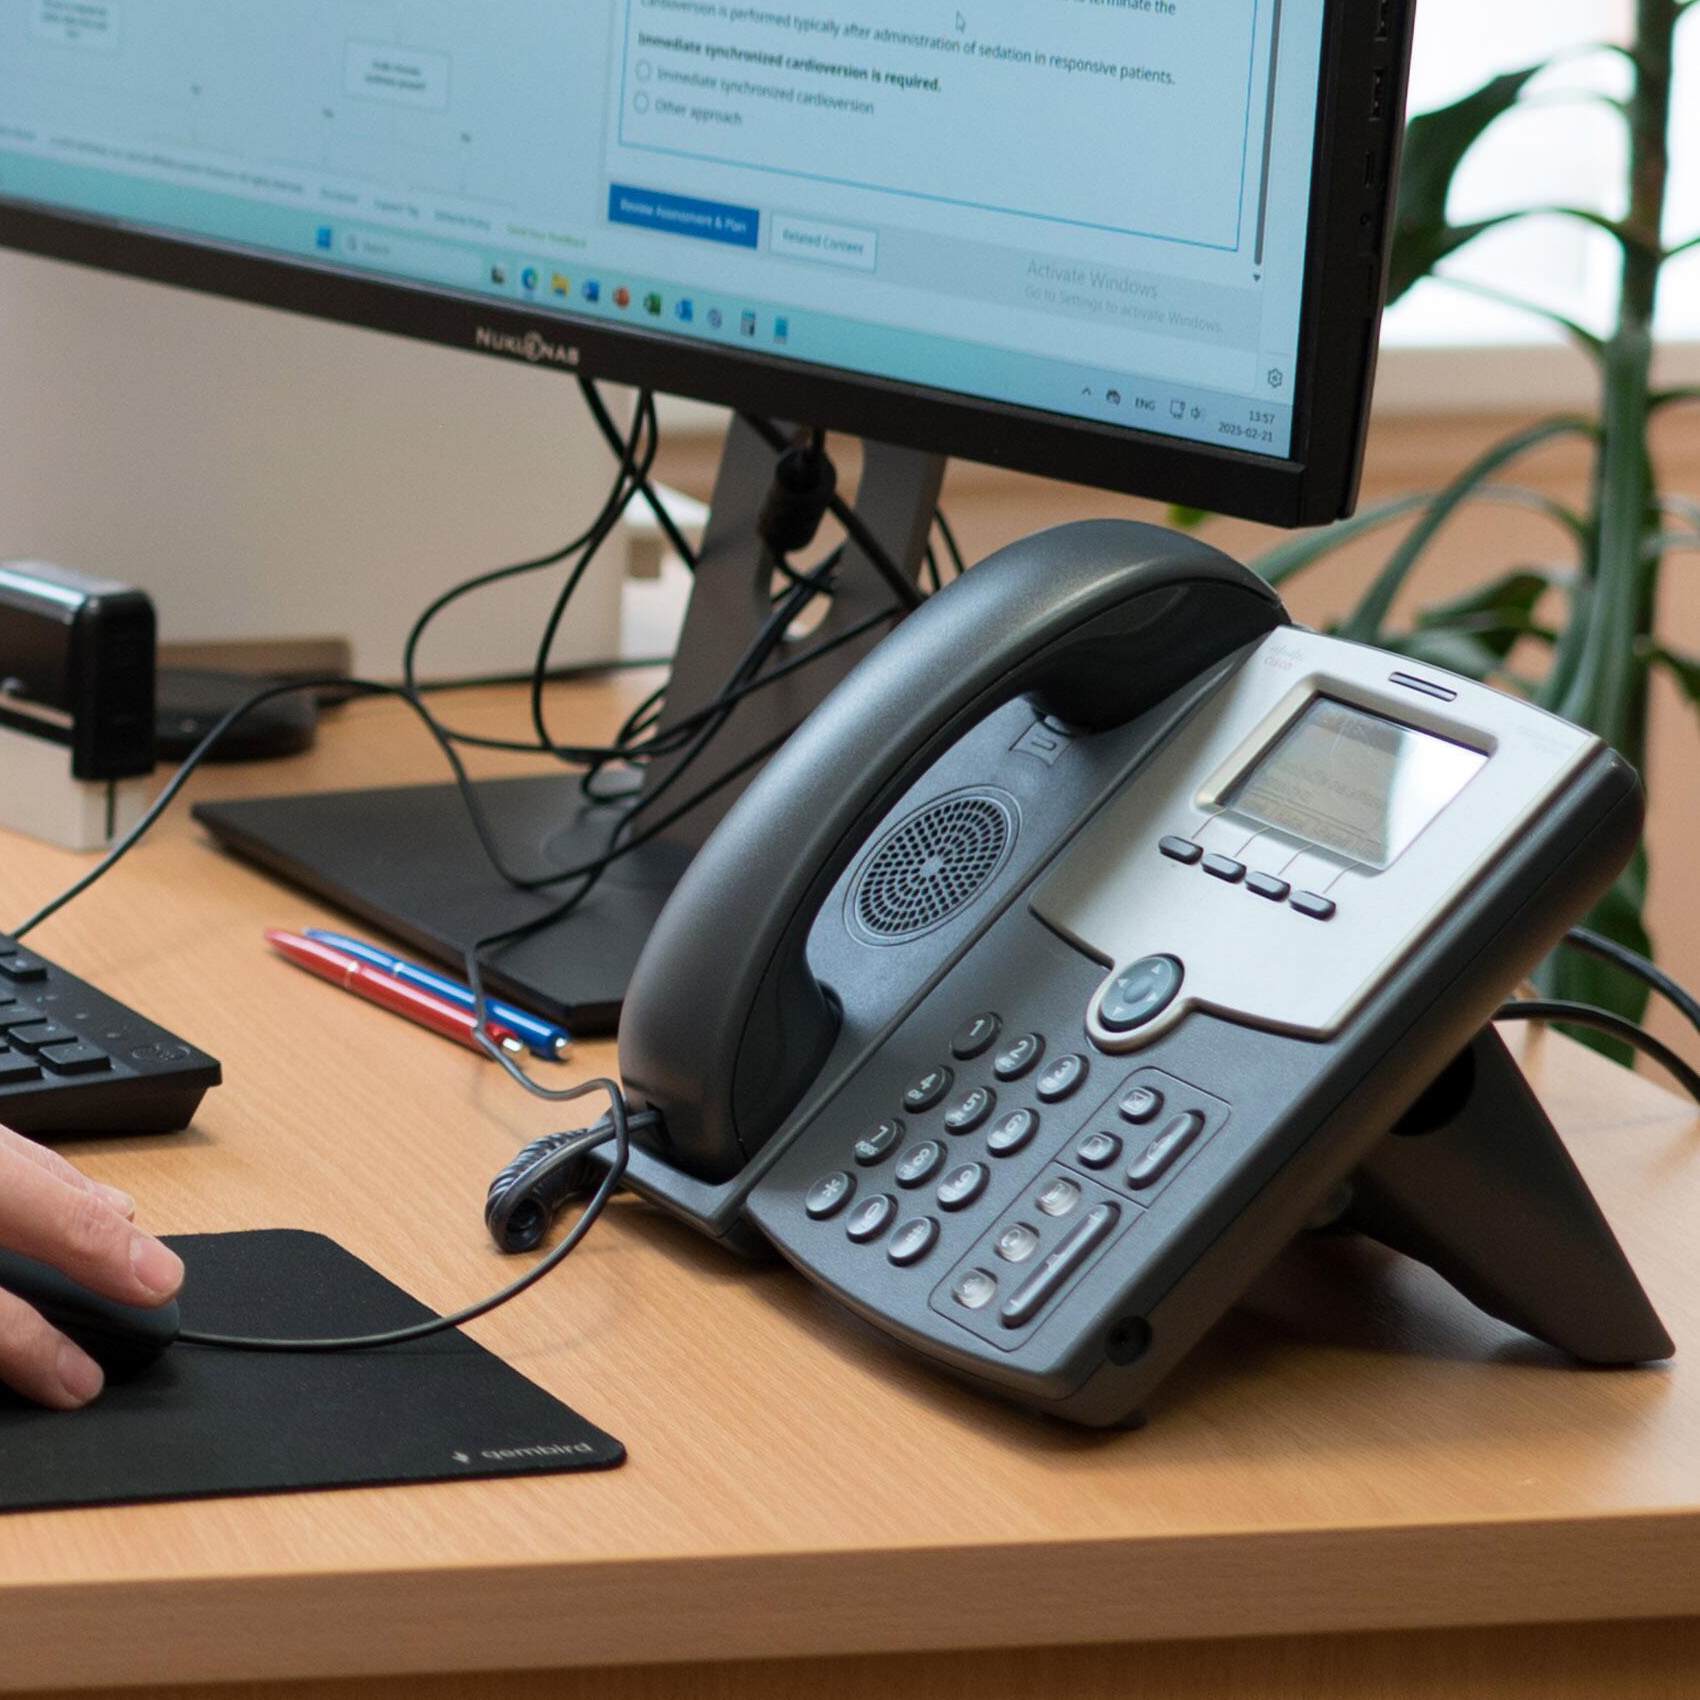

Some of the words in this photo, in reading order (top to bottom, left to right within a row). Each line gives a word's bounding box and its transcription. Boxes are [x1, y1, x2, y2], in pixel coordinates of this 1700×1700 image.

[730, 5, 791, 28] performed
[794, 15, 842, 36] typically
[845, 22, 871, 40] after
[873, 28, 960, 52] administration
[979, 43, 1031, 63] sedation
[1050, 53, 1117, 78] responsive
[1121, 65, 1176, 85] patients.
[638, 32, 702, 55] Immediate
[705, 39, 783, 68] synchronized
[786, 55, 869, 81] cardioversion
[884, 68, 942, 92] required.
[657, 67, 717, 89] Immediate
[720, 74, 794, 102] synchronized
[797, 87, 874, 114] cardioversion
[655, 100, 687, 117] Other
[690, 105, 743, 126] approach
[1027, 259, 1085, 285] Activate
[1090, 271, 1158, 299] Windows
[1059, 291, 1104, 313] Settings
[1121, 302, 1165, 322] activate
[1135, 396, 1156, 412] ENG
[1249, 409, 1275, 425] 13:57
[1218, 421, 1274, 443] 2025-02-21
[970, 1020, 985, 1036] 1
[1010, 1040, 1028, 1058] 2
[1055, 1060, 1072, 1079] 3
[921, 1073, 937, 1090] 4
[963, 1092, 981, 1112] 5
[1005, 1114, 1023, 1133] 6
[871, 1125, 889, 1143] 7
[914, 1148, 930, 1166] 8
[955, 1170, 973, 1188] 9
[482, 1442, 593, 1460] gembird
